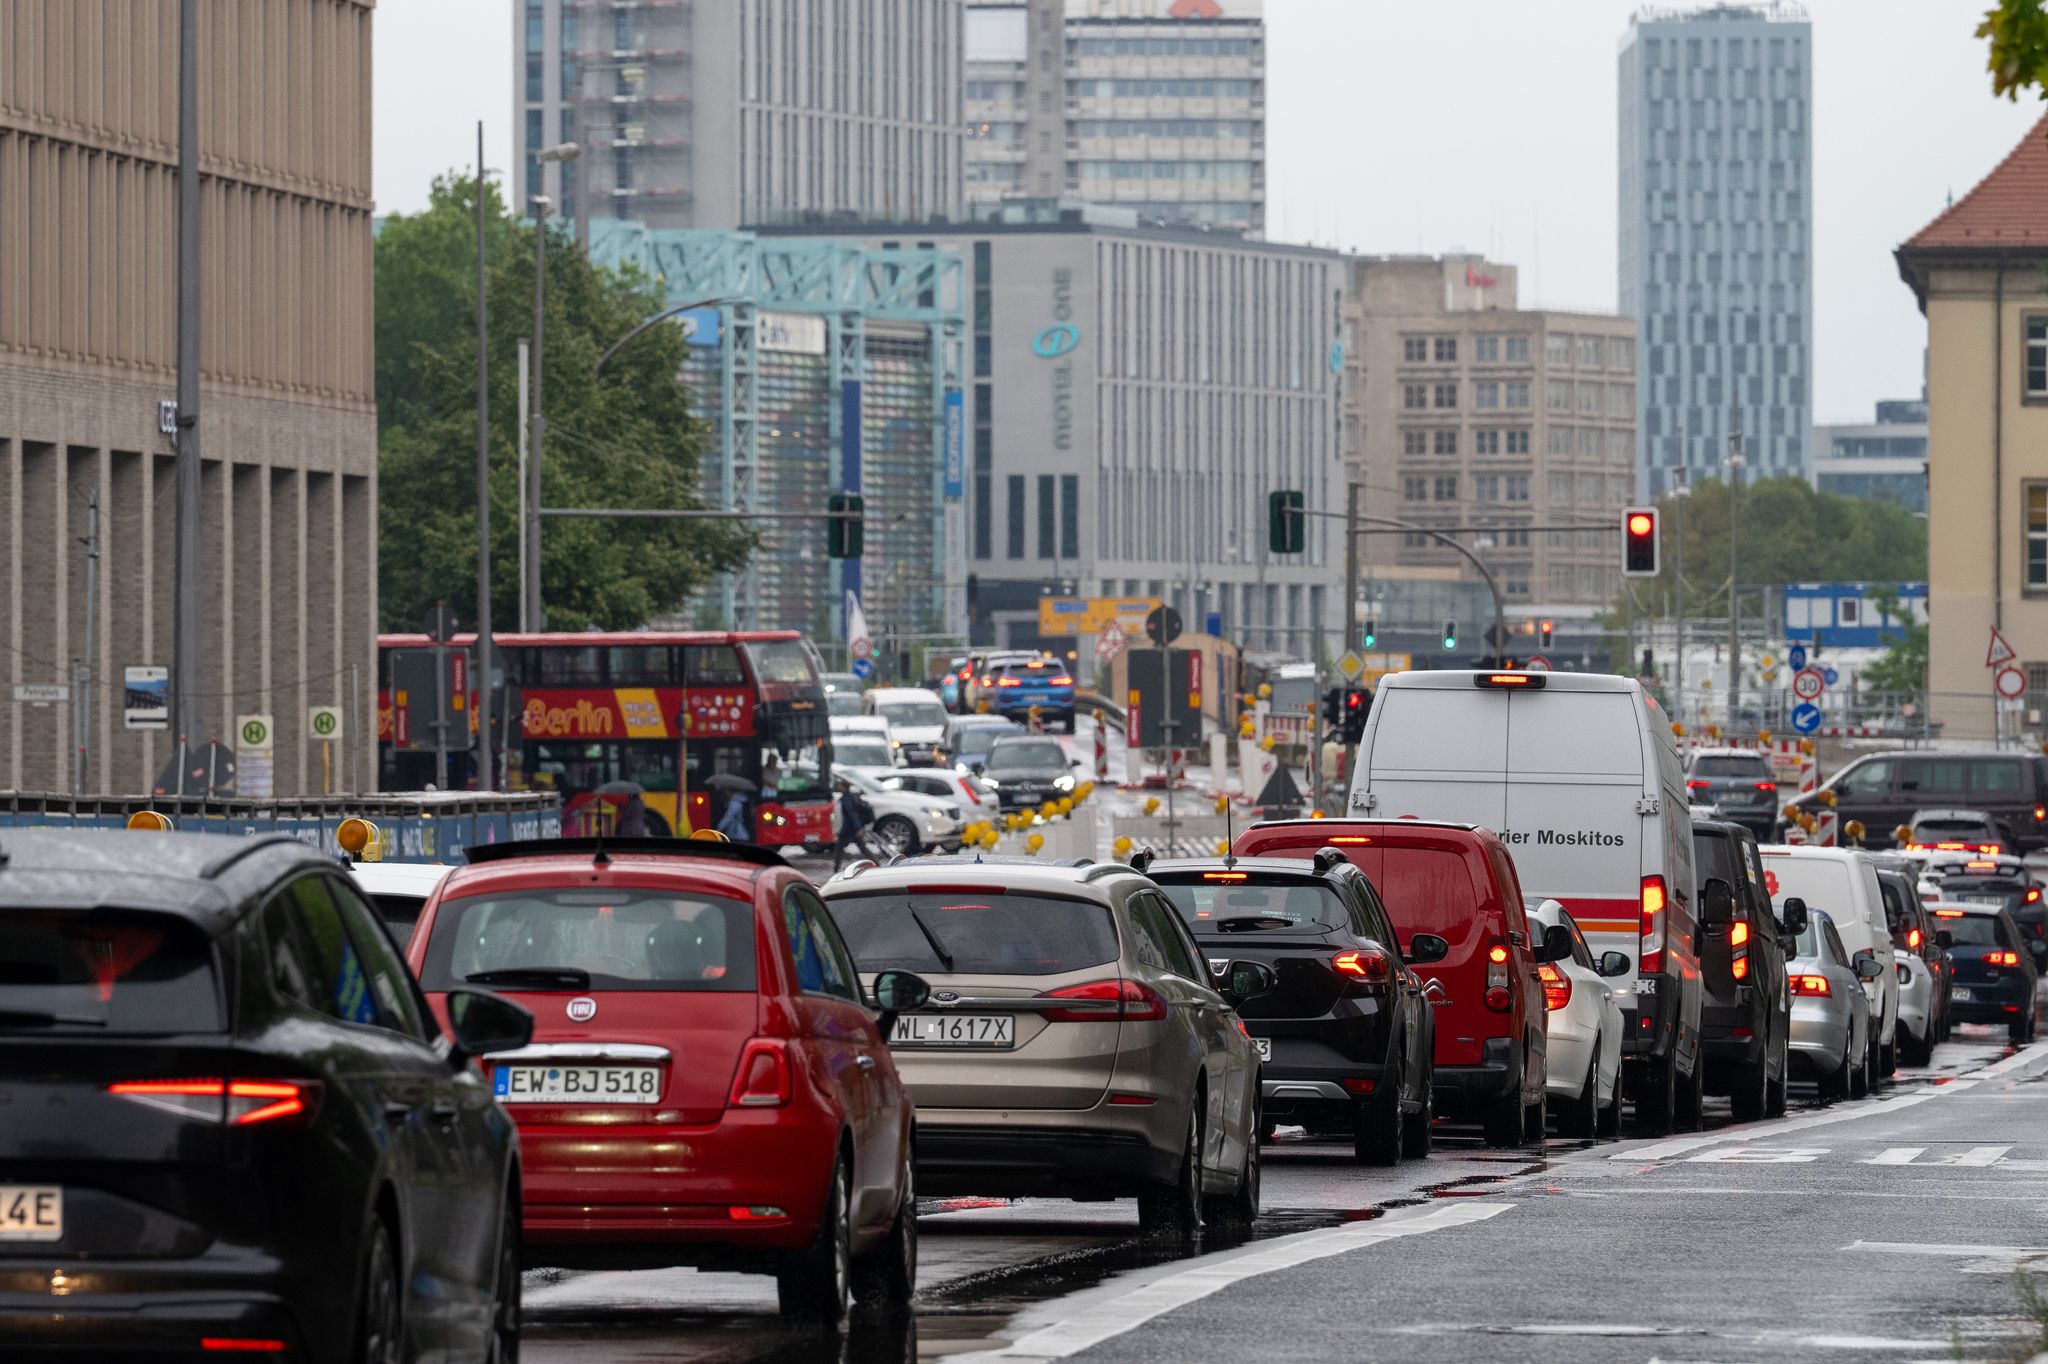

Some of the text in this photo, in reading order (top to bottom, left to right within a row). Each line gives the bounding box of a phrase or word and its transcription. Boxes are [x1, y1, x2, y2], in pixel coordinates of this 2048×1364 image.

[1800, 678, 1817, 692] 30
[526, 698, 613, 735] Berlin
[1537, 829, 1624, 847] Moskitos
[897, 1017, 1008, 1040] WL 1617X
